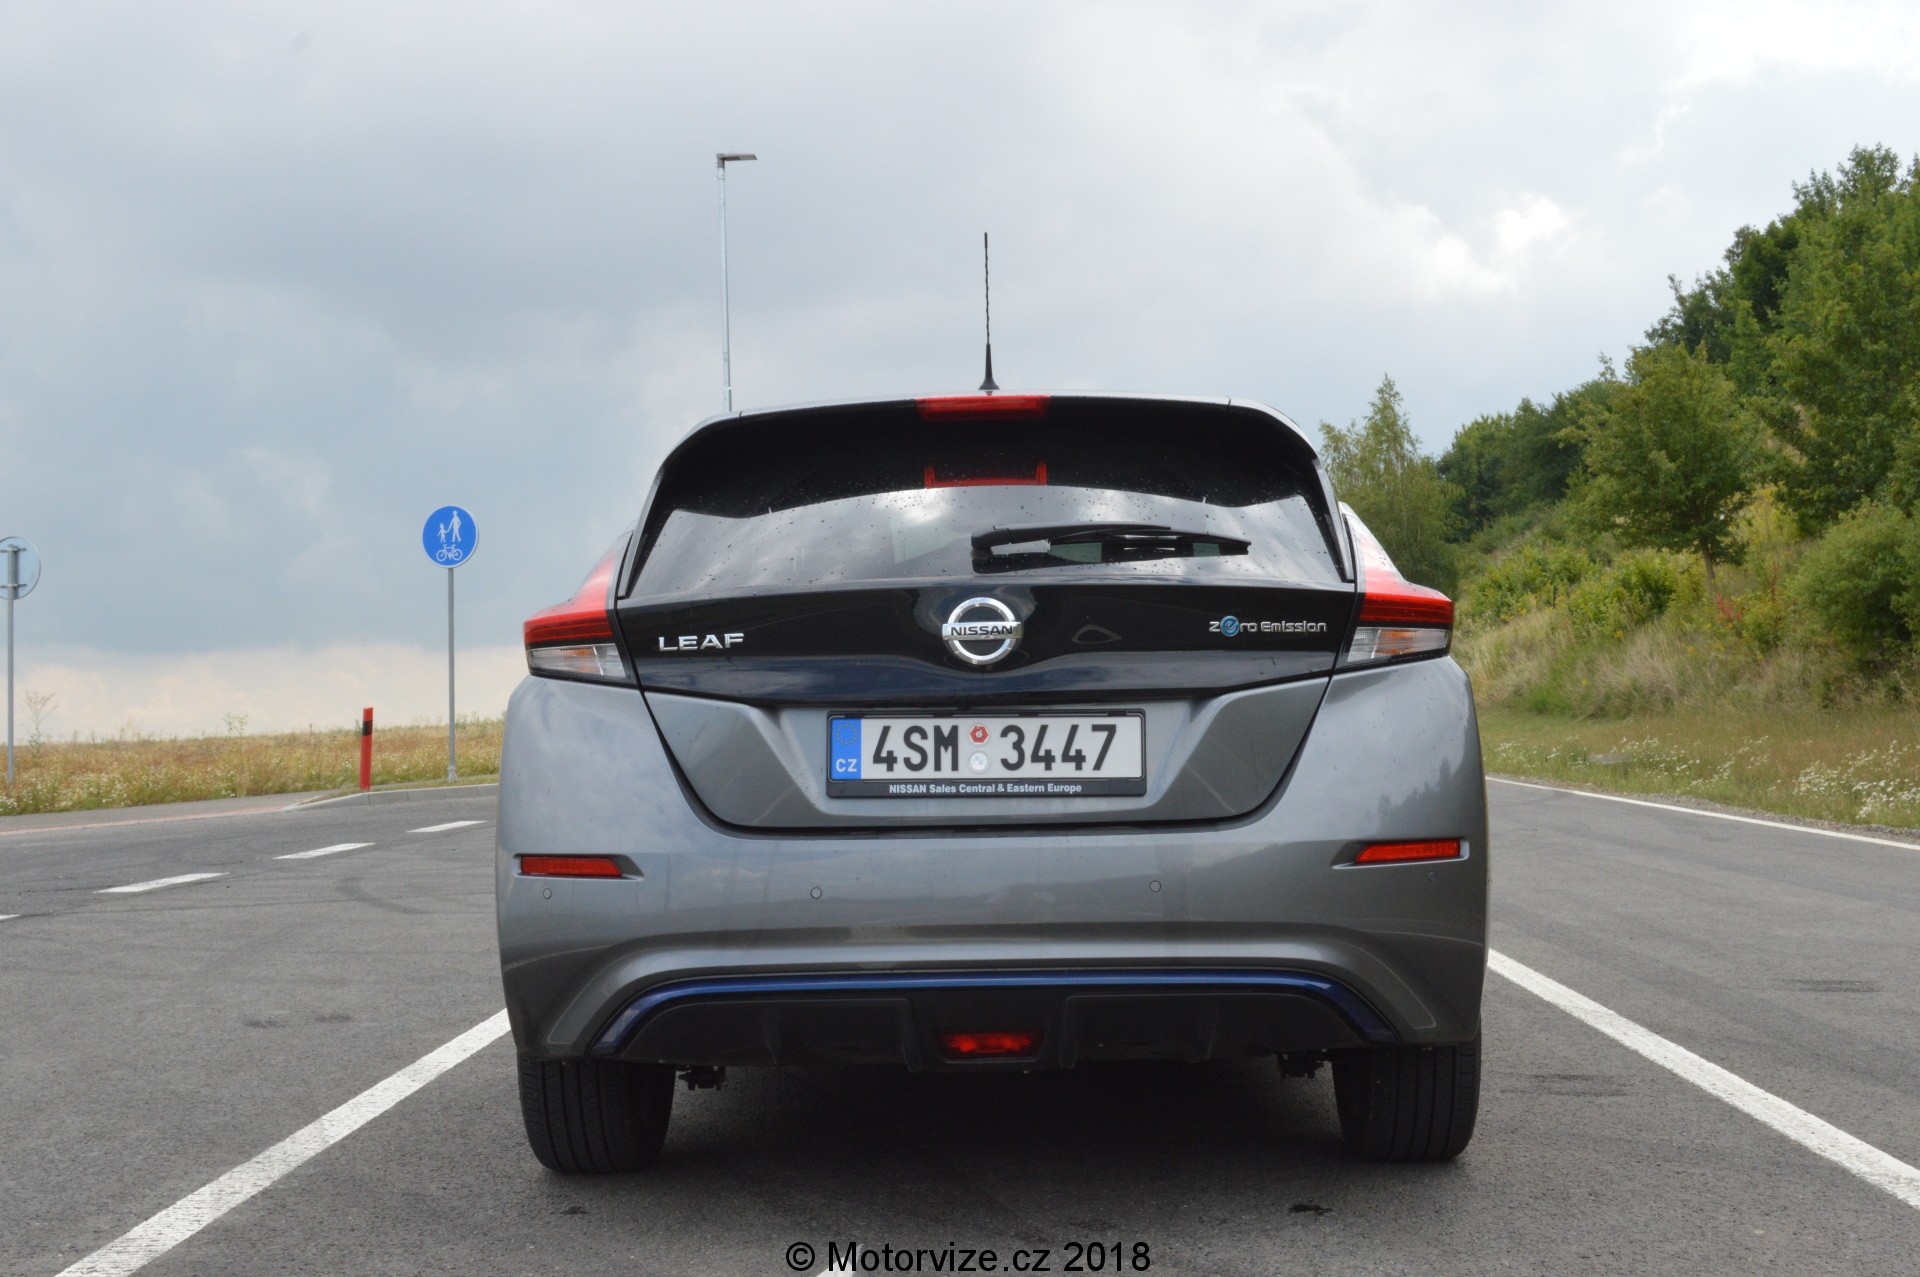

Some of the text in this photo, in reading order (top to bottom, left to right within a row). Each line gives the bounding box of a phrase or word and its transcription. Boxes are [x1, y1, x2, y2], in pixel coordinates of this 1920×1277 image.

[950, 625, 1013, 637] NISSAN
[1260, 620, 1328, 633] Emission
[658, 632, 745, 652] LEAF
[872, 724, 1117, 772] 4SM 3447
[835, 758, 858, 773] CZ
[889, 783, 1082, 795] NISSAN Sales Central & Eastern Europe
